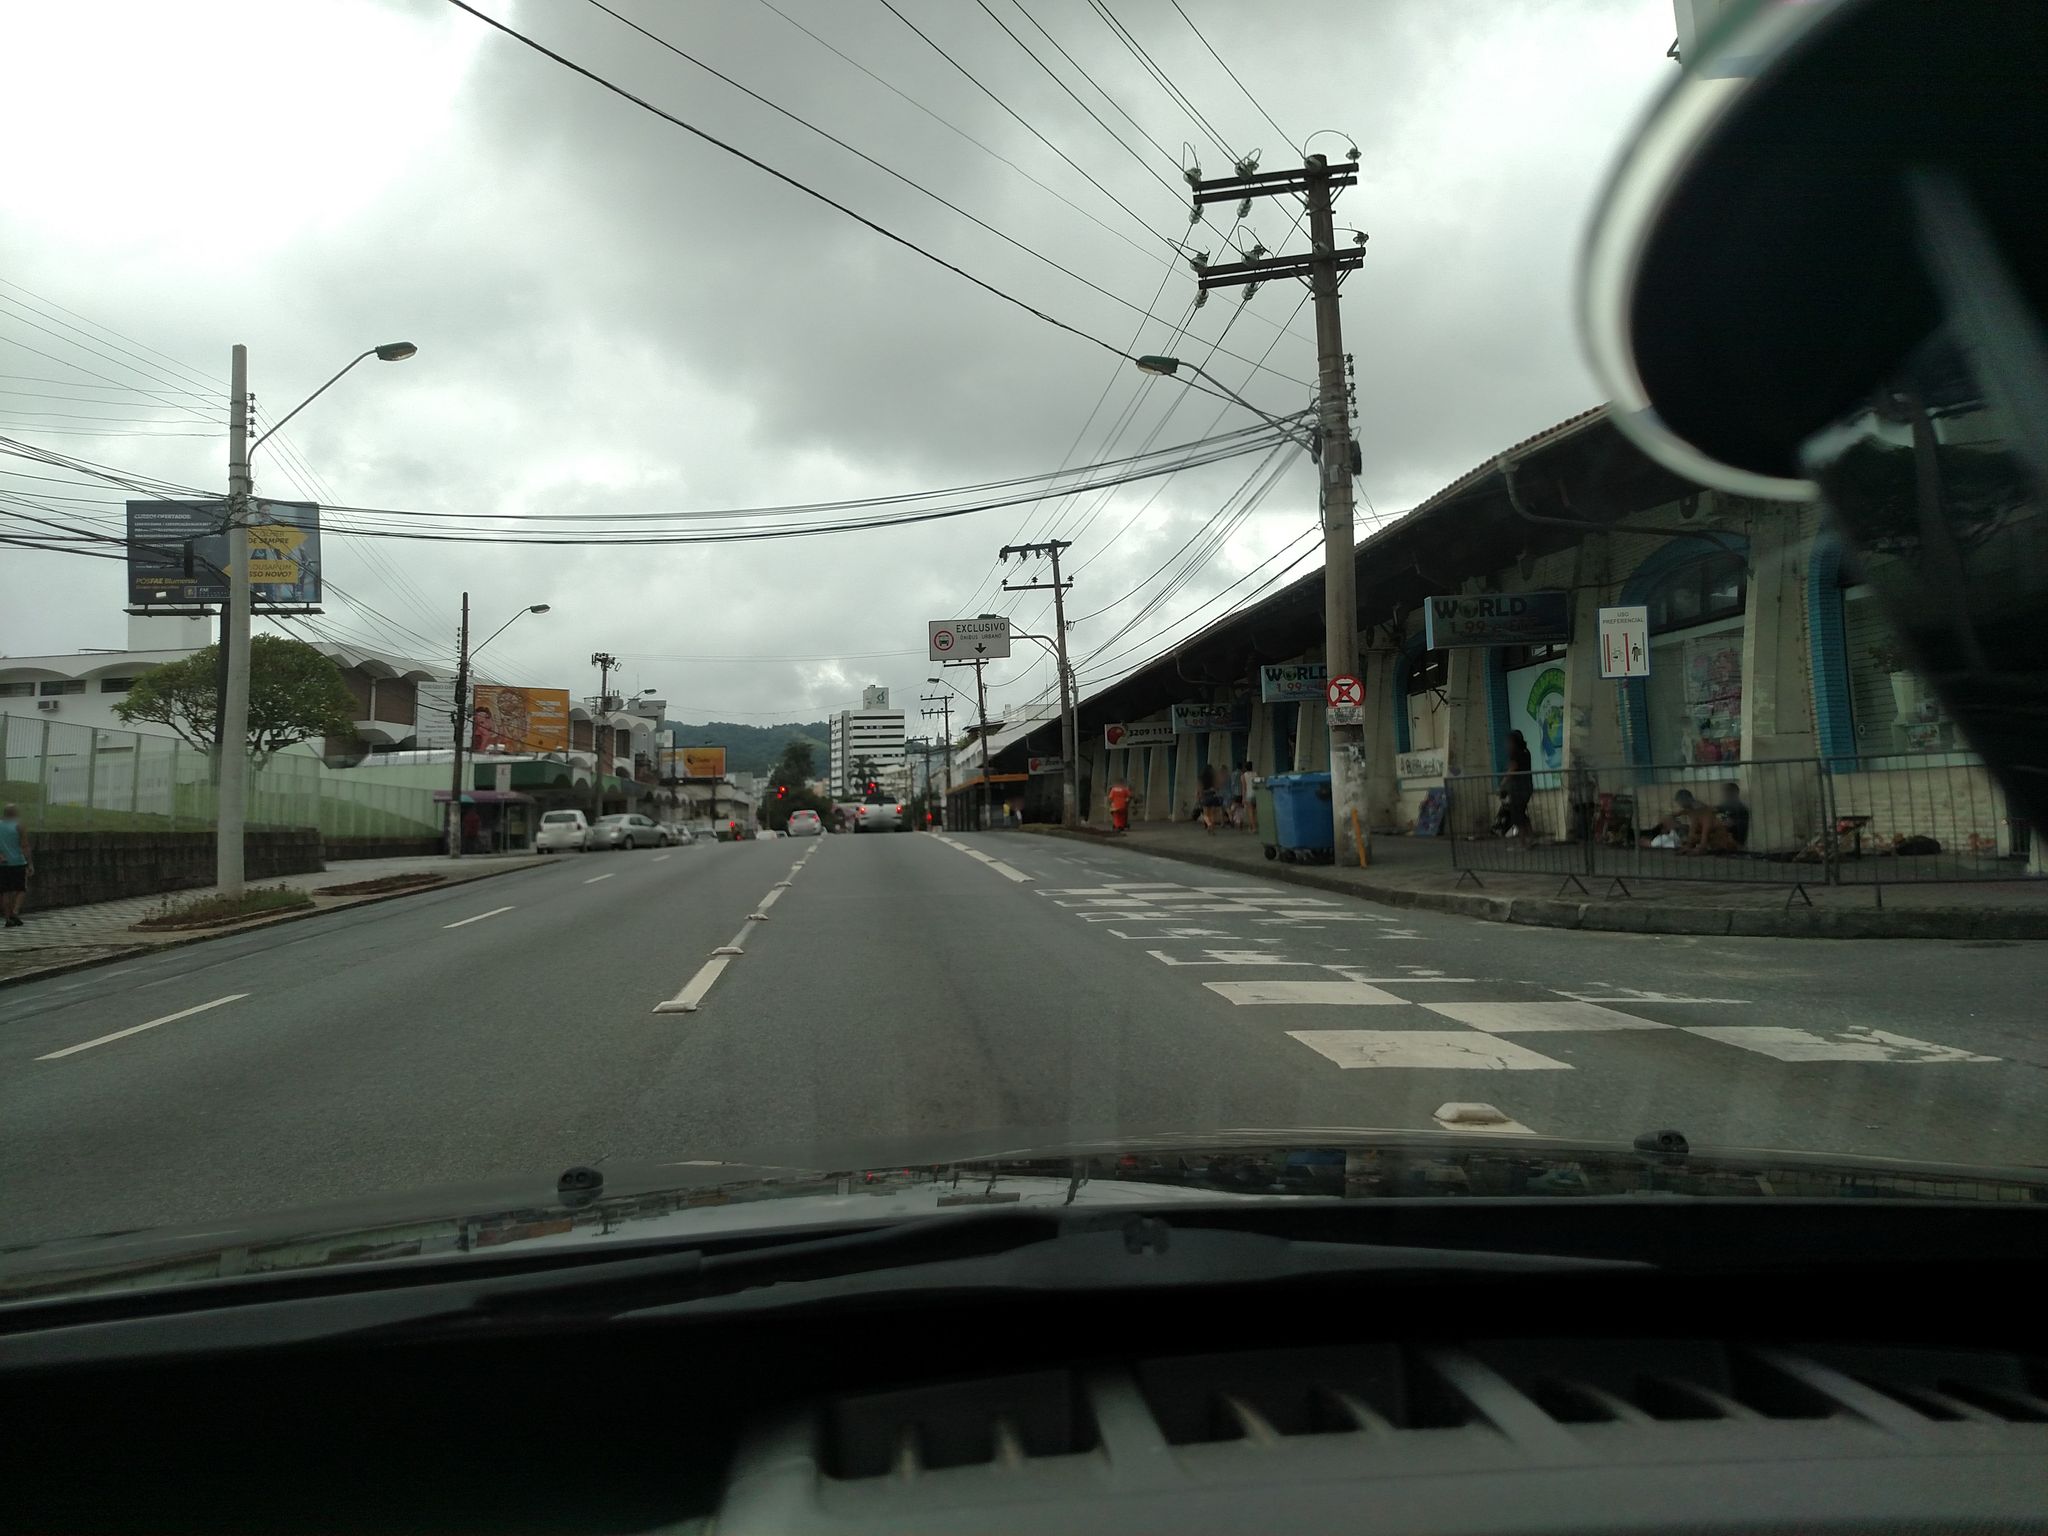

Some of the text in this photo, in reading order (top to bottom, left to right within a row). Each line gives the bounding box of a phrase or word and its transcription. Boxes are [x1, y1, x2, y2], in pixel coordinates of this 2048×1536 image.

[1434, 597, 1527, 619] WORLD
[956, 623, 1006, 633] EXCLUSIVO
[1129, 728, 1150, 737] 3209
